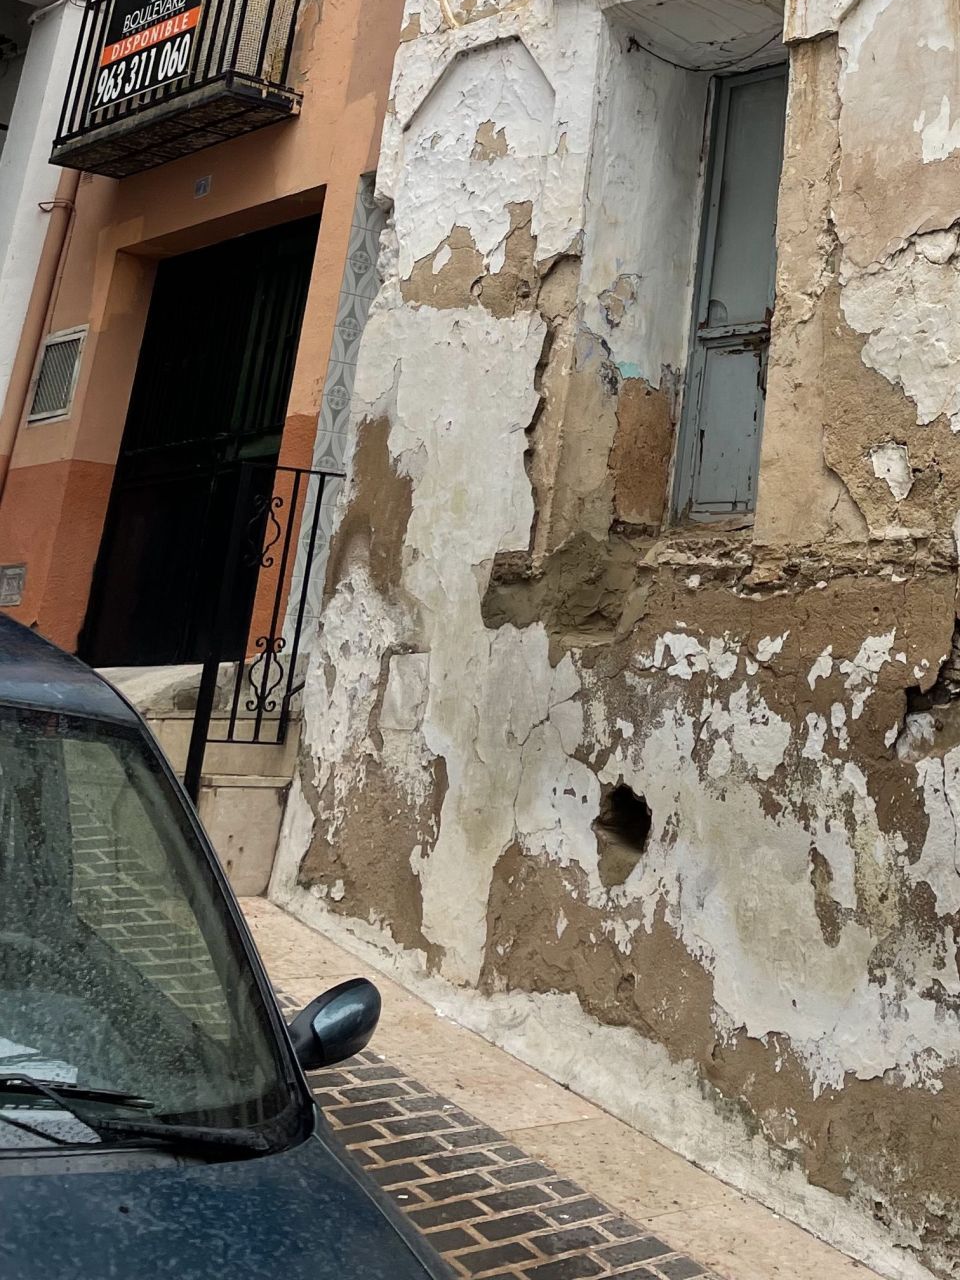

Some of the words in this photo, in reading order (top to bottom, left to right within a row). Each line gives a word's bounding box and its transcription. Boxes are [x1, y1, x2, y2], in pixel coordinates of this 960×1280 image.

[111, 12, 189, 60] DISPONIBLE
[95, 61, 126, 107] 963
[125, 48, 156, 95] 311
[158, 33, 190, 81] 060
